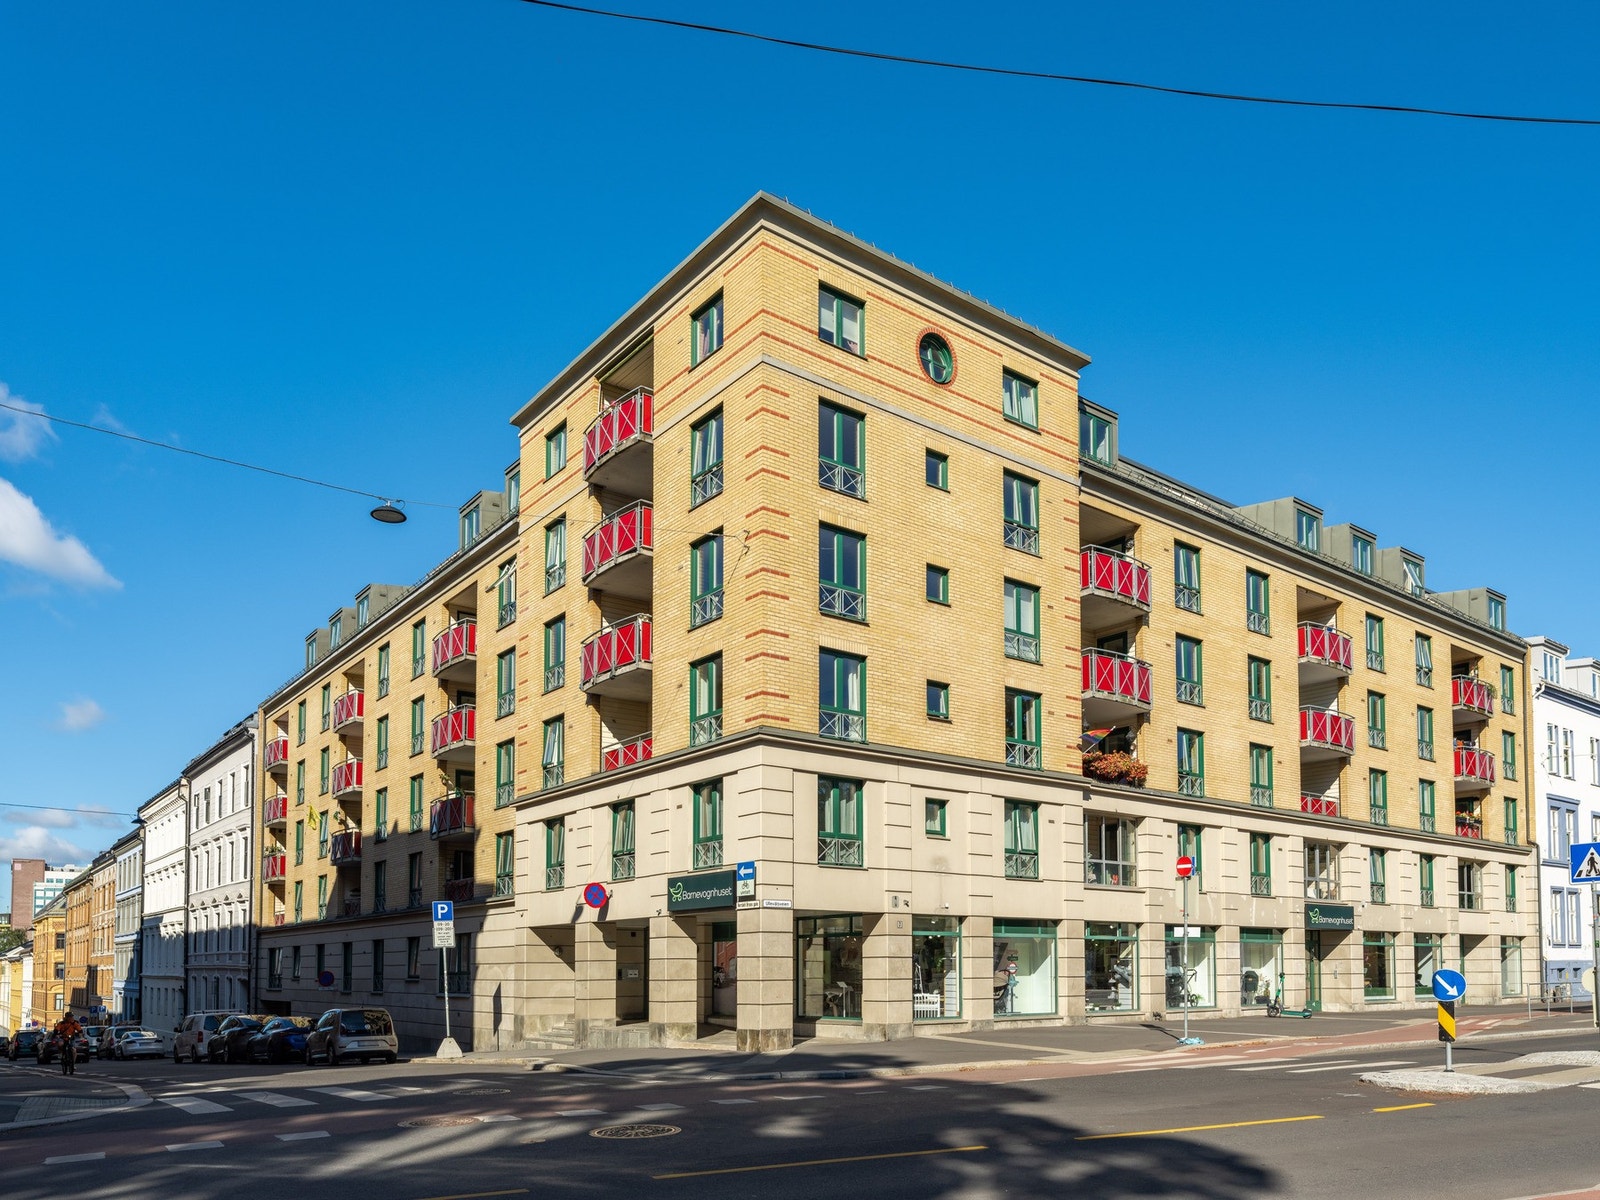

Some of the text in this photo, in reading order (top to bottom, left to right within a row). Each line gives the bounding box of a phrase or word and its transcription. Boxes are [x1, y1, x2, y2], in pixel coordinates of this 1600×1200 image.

[682, 887, 732, 900] Barnevognhuset
[437, 904, 448, 919] P
[1319, 915, 1353, 925] Barnevognhuset
